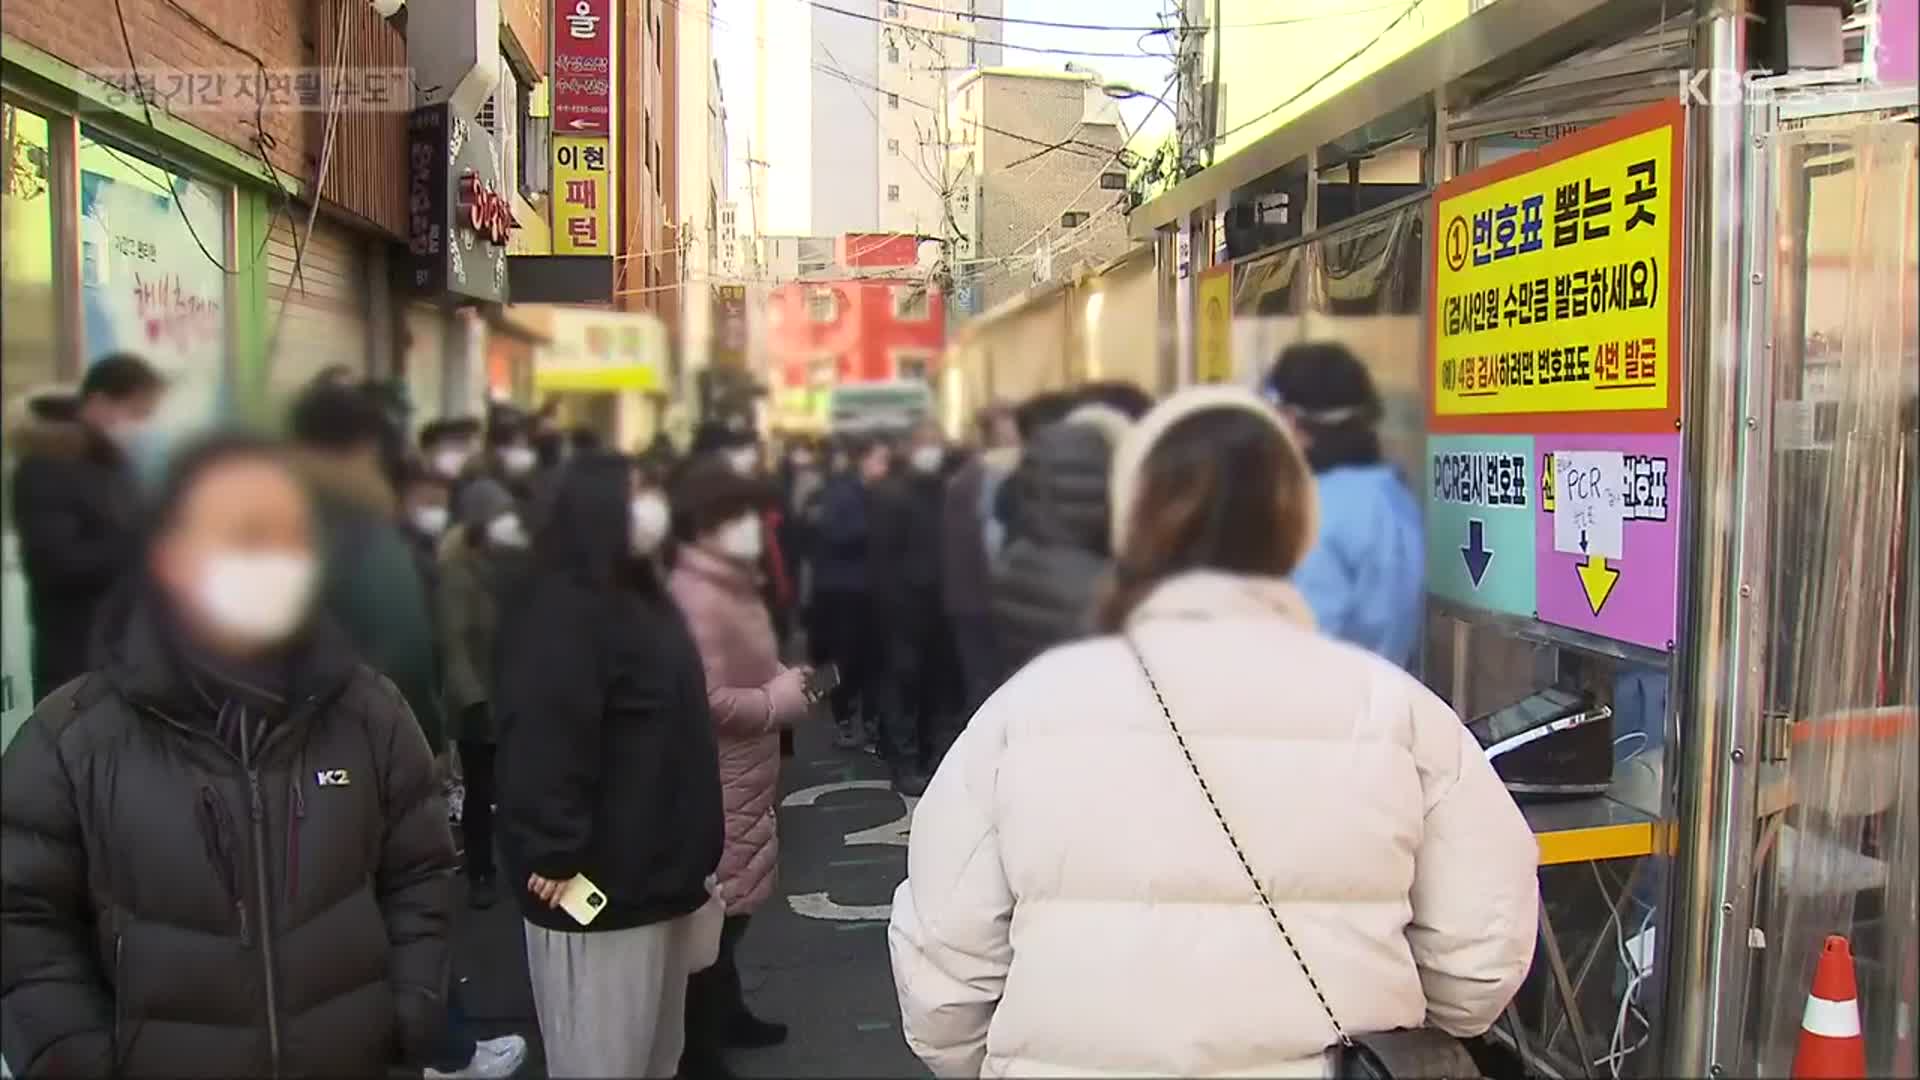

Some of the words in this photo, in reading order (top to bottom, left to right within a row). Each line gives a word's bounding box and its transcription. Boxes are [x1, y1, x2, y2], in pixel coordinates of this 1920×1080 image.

[557, 145, 606, 172] 이현
[565, 178, 598, 248] 패턴
[1472, 194, 1545, 266] 번호표
[1553, 177, 1613, 249] 뽑는
[1624, 159, 1658, 232] 곳
[1443, 286, 1499, 337] (검사인원
[1503, 278, 1549, 329] 수만큼
[1554, 258, 1659, 320] 발급하세요)
[1478, 348, 1535, 389] 검사하려면
[1538, 345, 1590, 386] 번호표도
[1594, 342, 1620, 382] 4번
[1625, 338, 1657, 379] 발급
[1433, 450, 1484, 505] PCR검사
[1486, 453, 1527, 507] 번호표
[1567, 467, 1602, 501] PCR
[317, 770, 350, 786] K2
